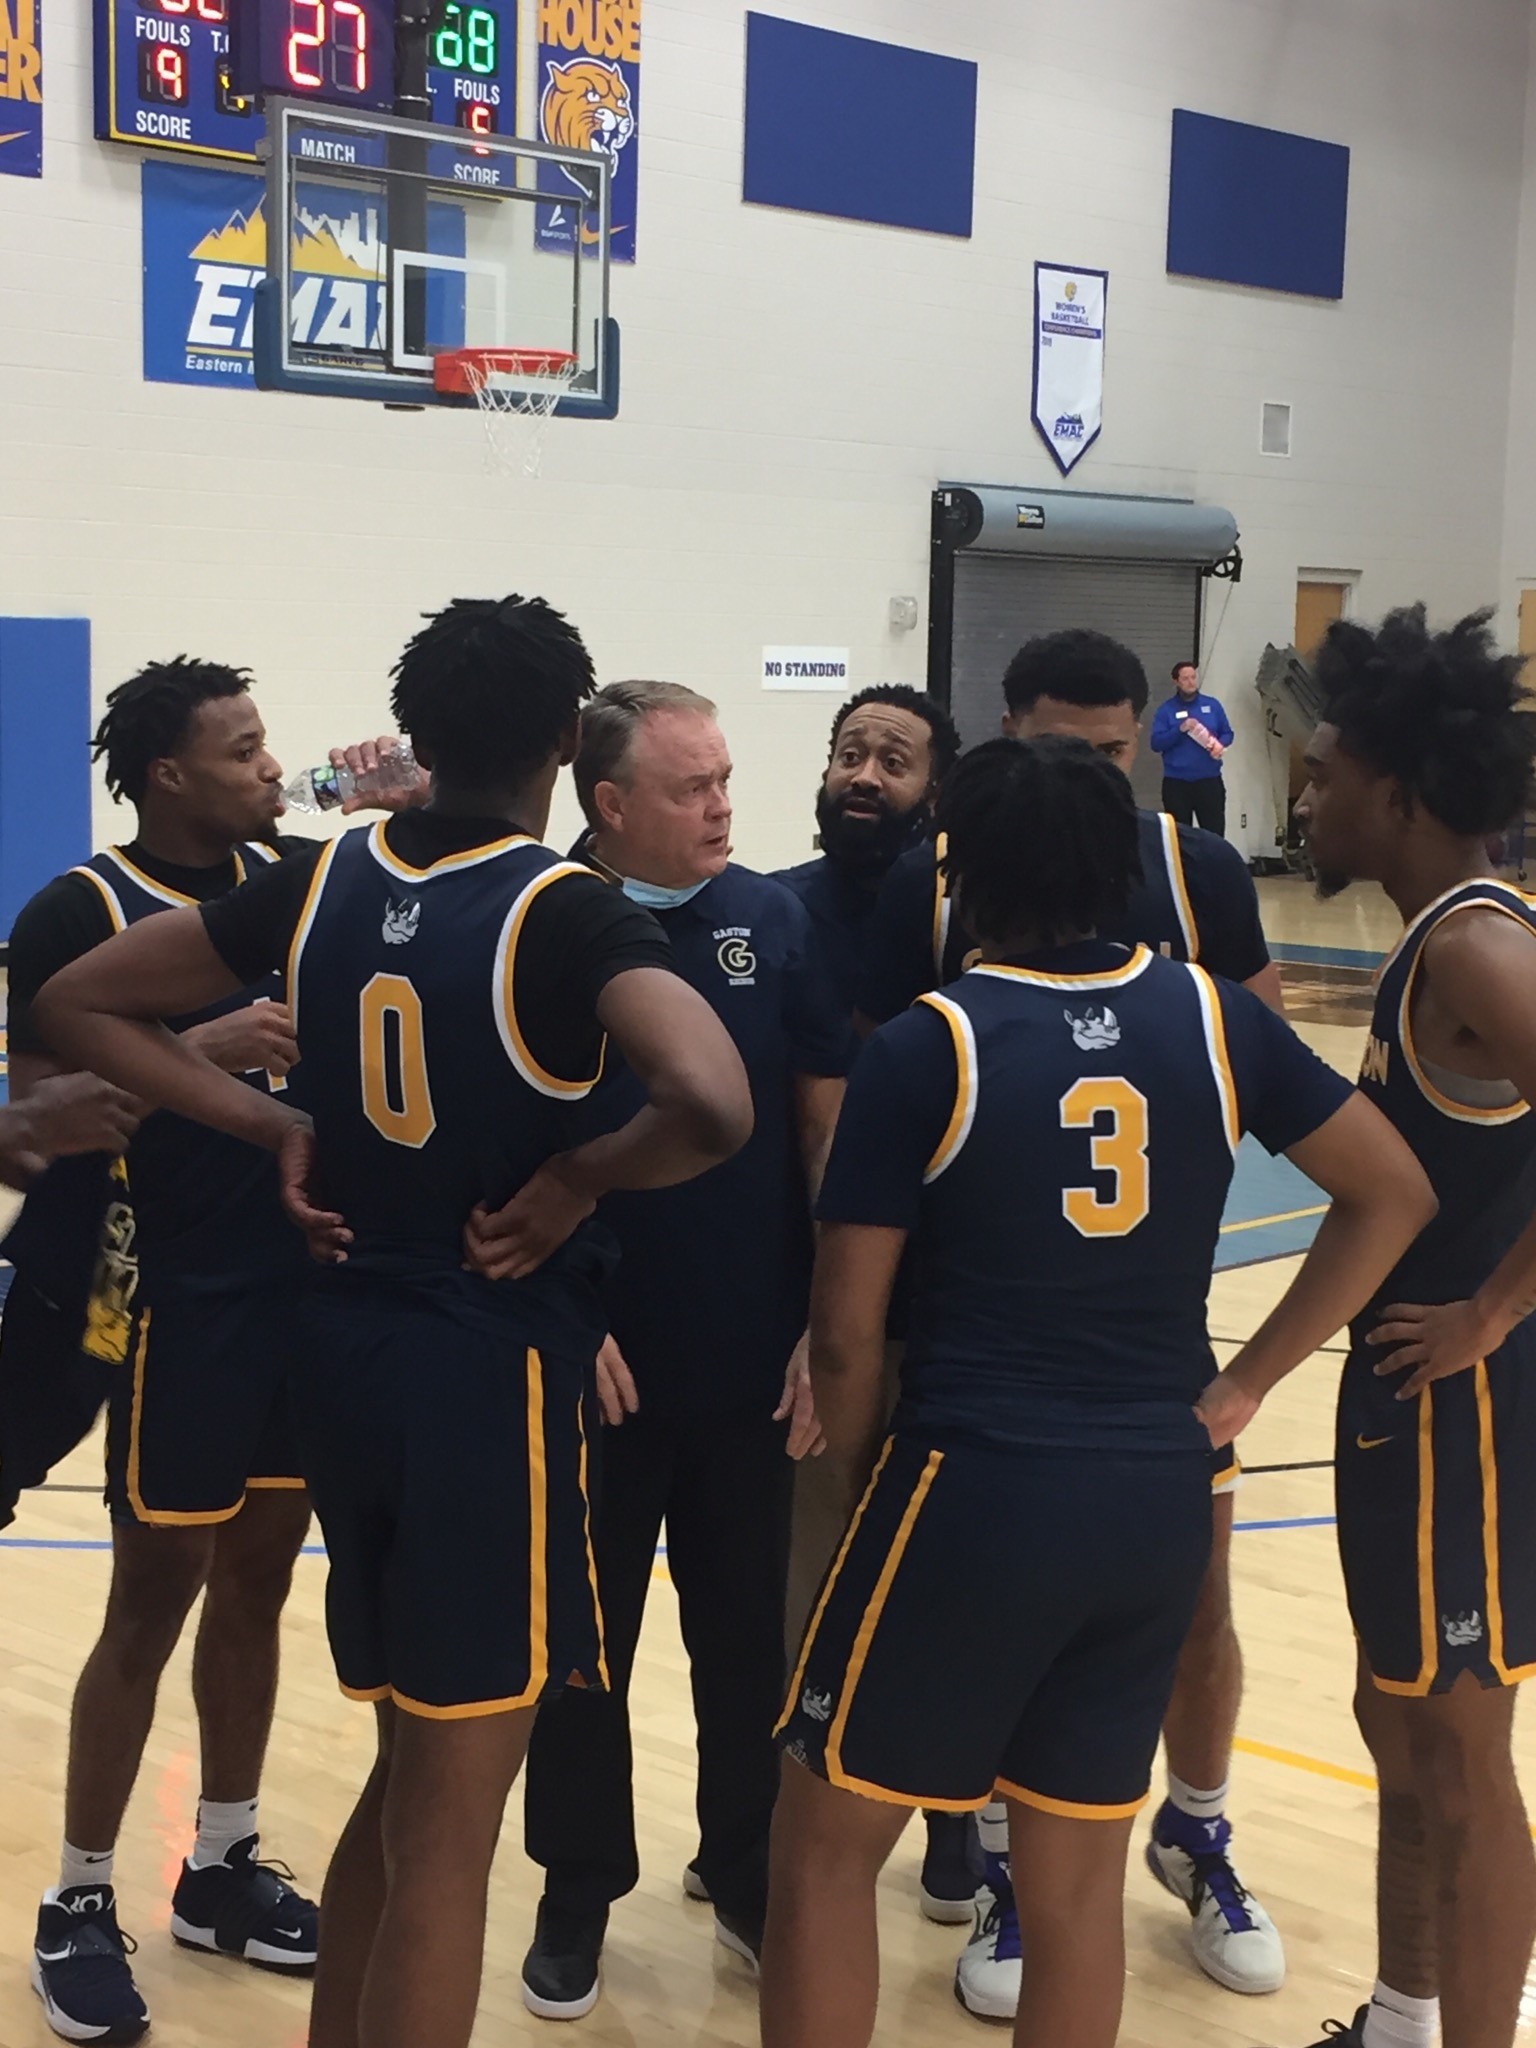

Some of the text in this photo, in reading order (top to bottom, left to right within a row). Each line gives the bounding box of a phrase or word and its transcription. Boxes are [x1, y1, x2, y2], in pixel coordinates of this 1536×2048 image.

[135, 16, 191, 47] FOULS
[539, 0, 641, 63] HOUSE
[288, 0, 367, 93] 27
[157, 48, 183, 99] 9
[454, 78, 501, 105] FOULS
[135, 110, 192, 140] SCORE
[300, 138, 356, 163] MATCH
[454, 163, 501, 186] SCORE
[1051, 312, 1089, 326] BASKETBALL
[1056, 302, 1086, 314] WOMEN'S
[185, 355, 243, 374] Eastern
[1054, 423, 1084, 438] EMAC
[765, 662, 846, 677] NO STANDING
[712, 927, 751, 940] GASTON
[717, 938, 757, 977] G
[359, 971, 437, 1149] 0
[1059, 1076, 1149, 1238] 3
